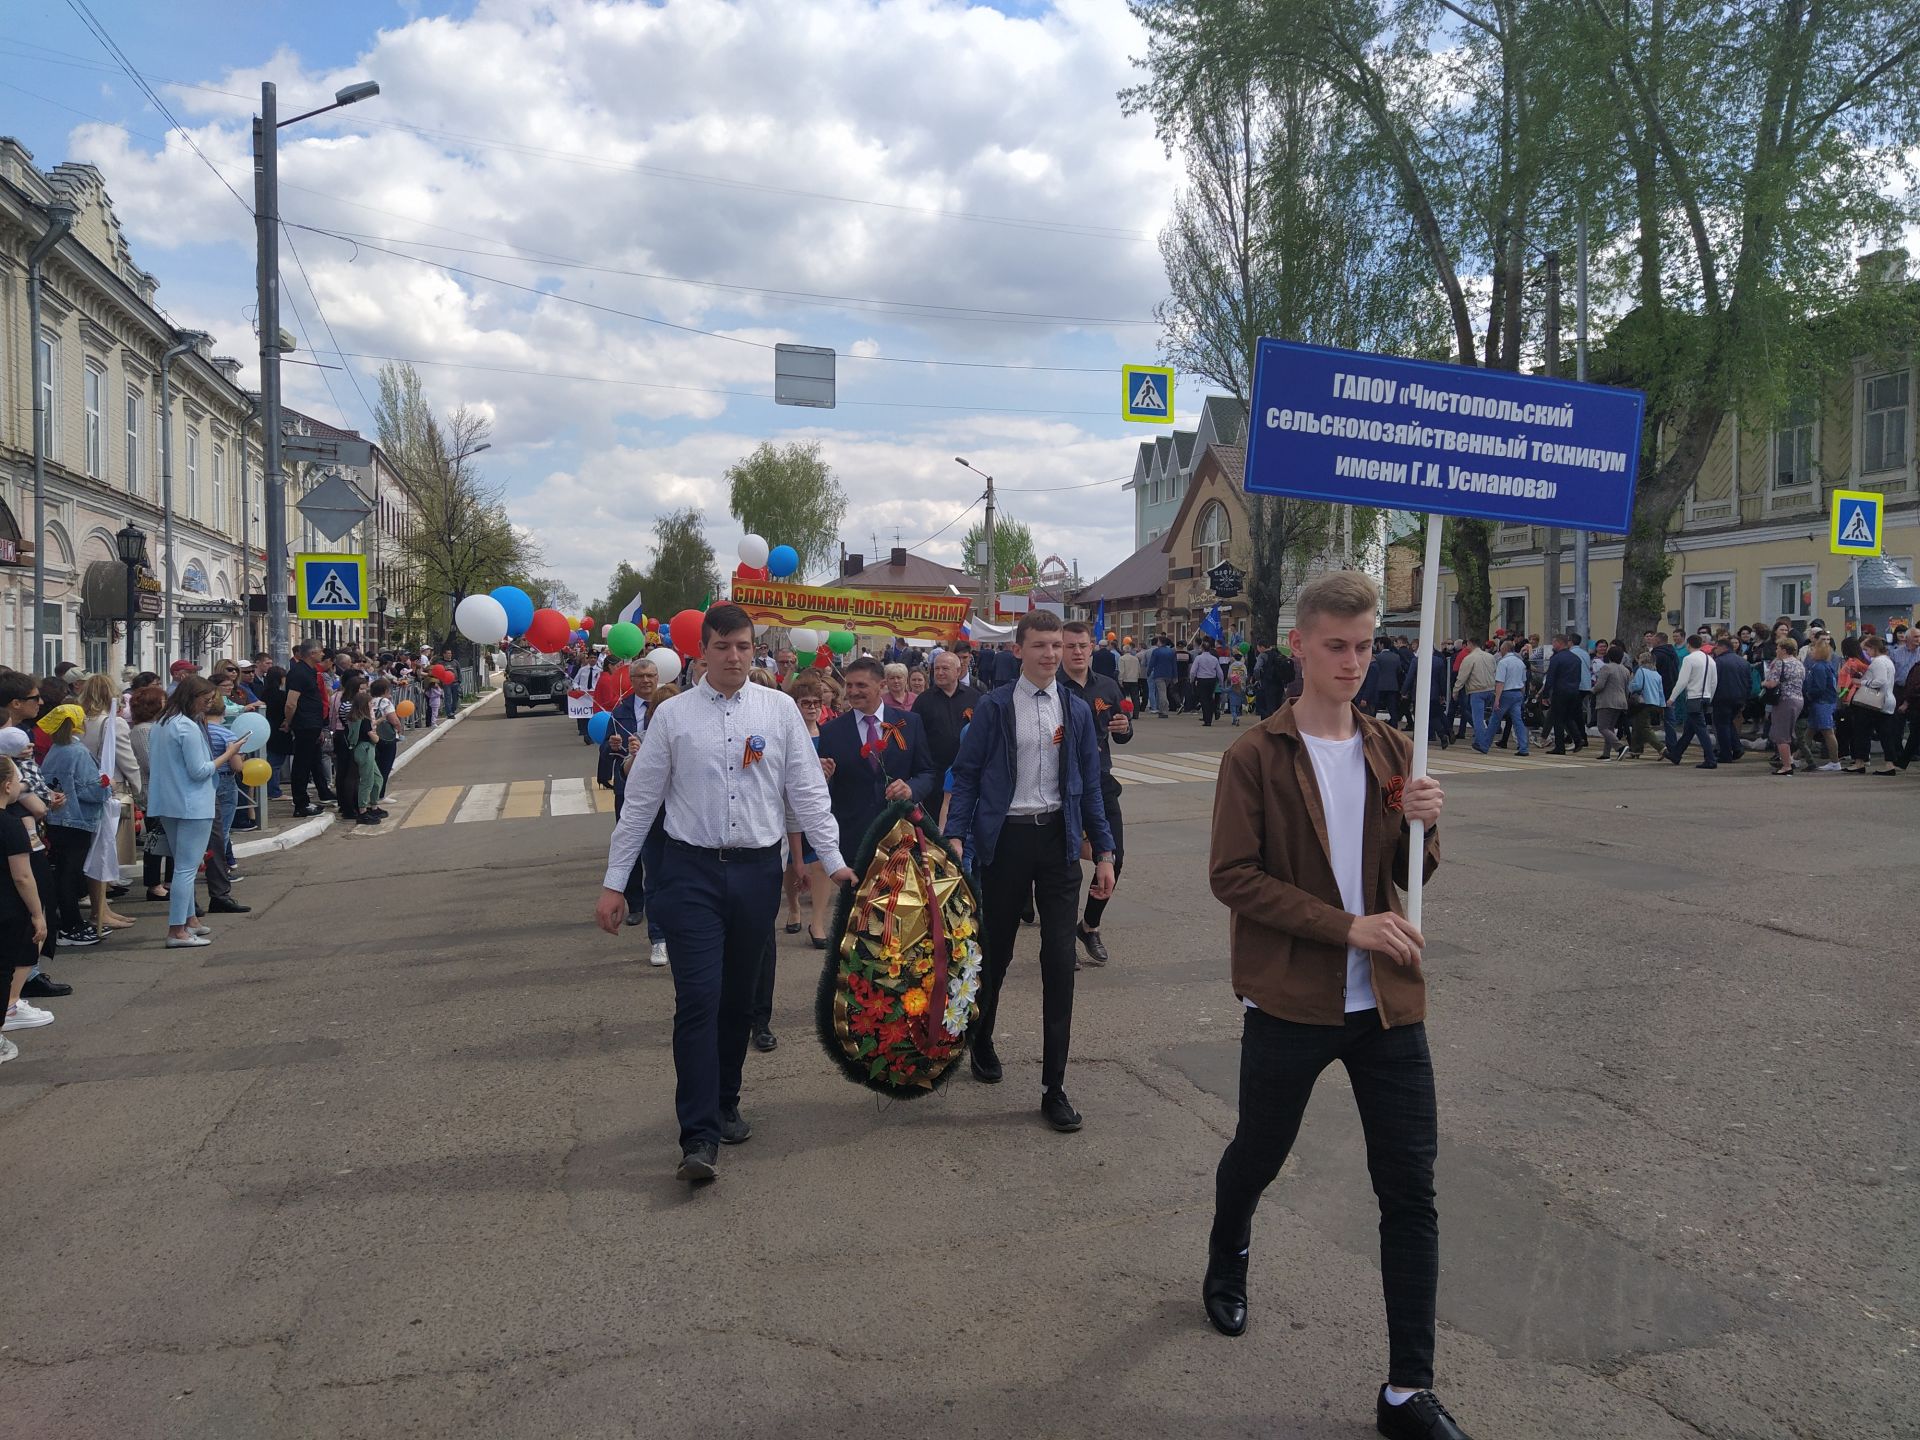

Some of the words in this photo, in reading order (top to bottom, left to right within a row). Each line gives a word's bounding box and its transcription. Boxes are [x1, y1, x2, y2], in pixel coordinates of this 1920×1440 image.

[1333, 372, 1397, 404] ГАПОУ
[1400, 383, 1574, 428] «Чистопольский
[1266, 407, 1528, 460] сельскохозяйственный
[1531, 441, 1627, 473] техникум
[1335, 455, 1408, 484] имени
[1410, 461, 1444, 489] Г.И.
[1448, 465, 1557, 500] Усманова»
[733, 586, 783, 607] СЛАВА
